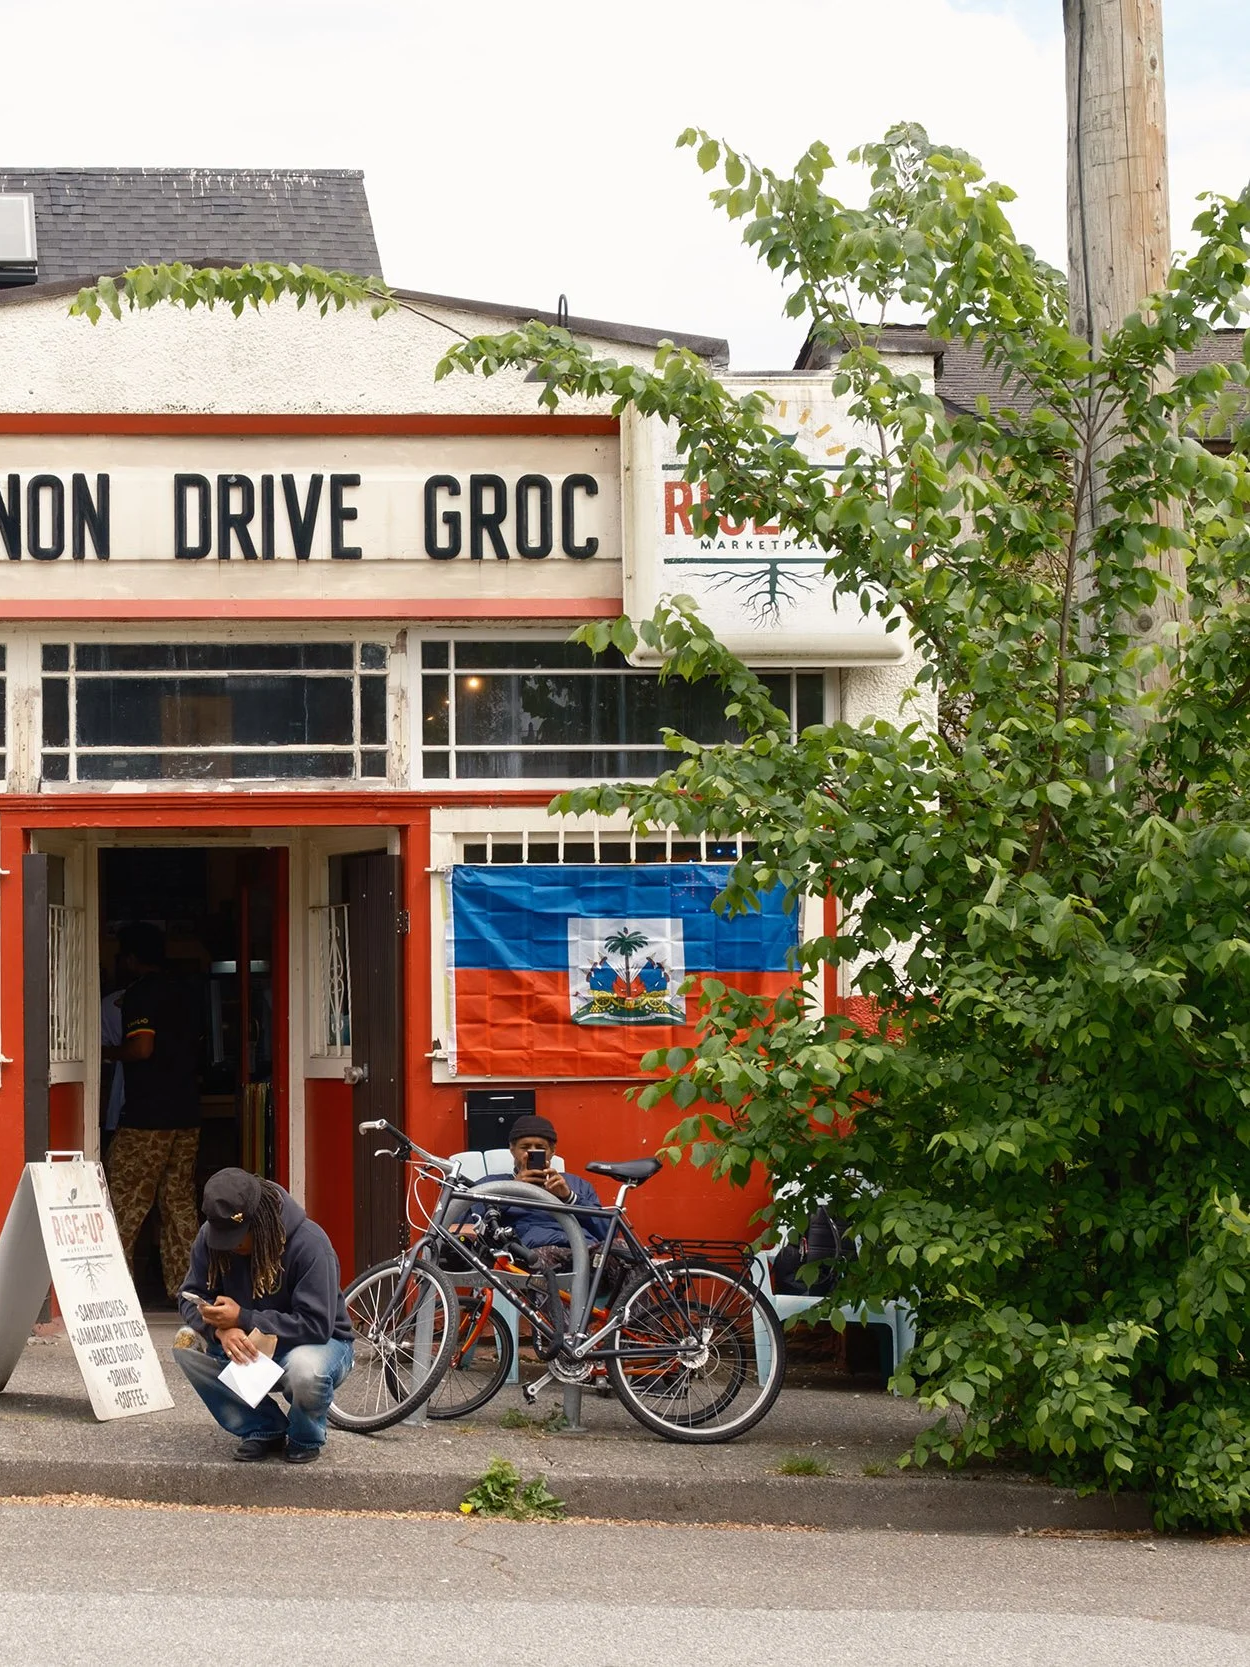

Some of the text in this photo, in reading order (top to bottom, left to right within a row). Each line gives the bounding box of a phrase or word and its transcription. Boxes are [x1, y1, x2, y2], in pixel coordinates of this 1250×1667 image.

[174, 473, 361, 560] DRIVE
[424, 473, 598, 560] GROC
[700, 540, 818, 550] MARKETPLA
[51, 1213, 104, 1246] RISE UP
[78, 1299, 127, 1322] SANDWICHES
[76, 1319, 144, 1345] JAMAICAN PATTIES
[91, 1343, 142, 1367] BAKED GOODS
[110, 1366, 139, 1387] DRINKS
[117, 1388, 147, 1409] COFFEE
